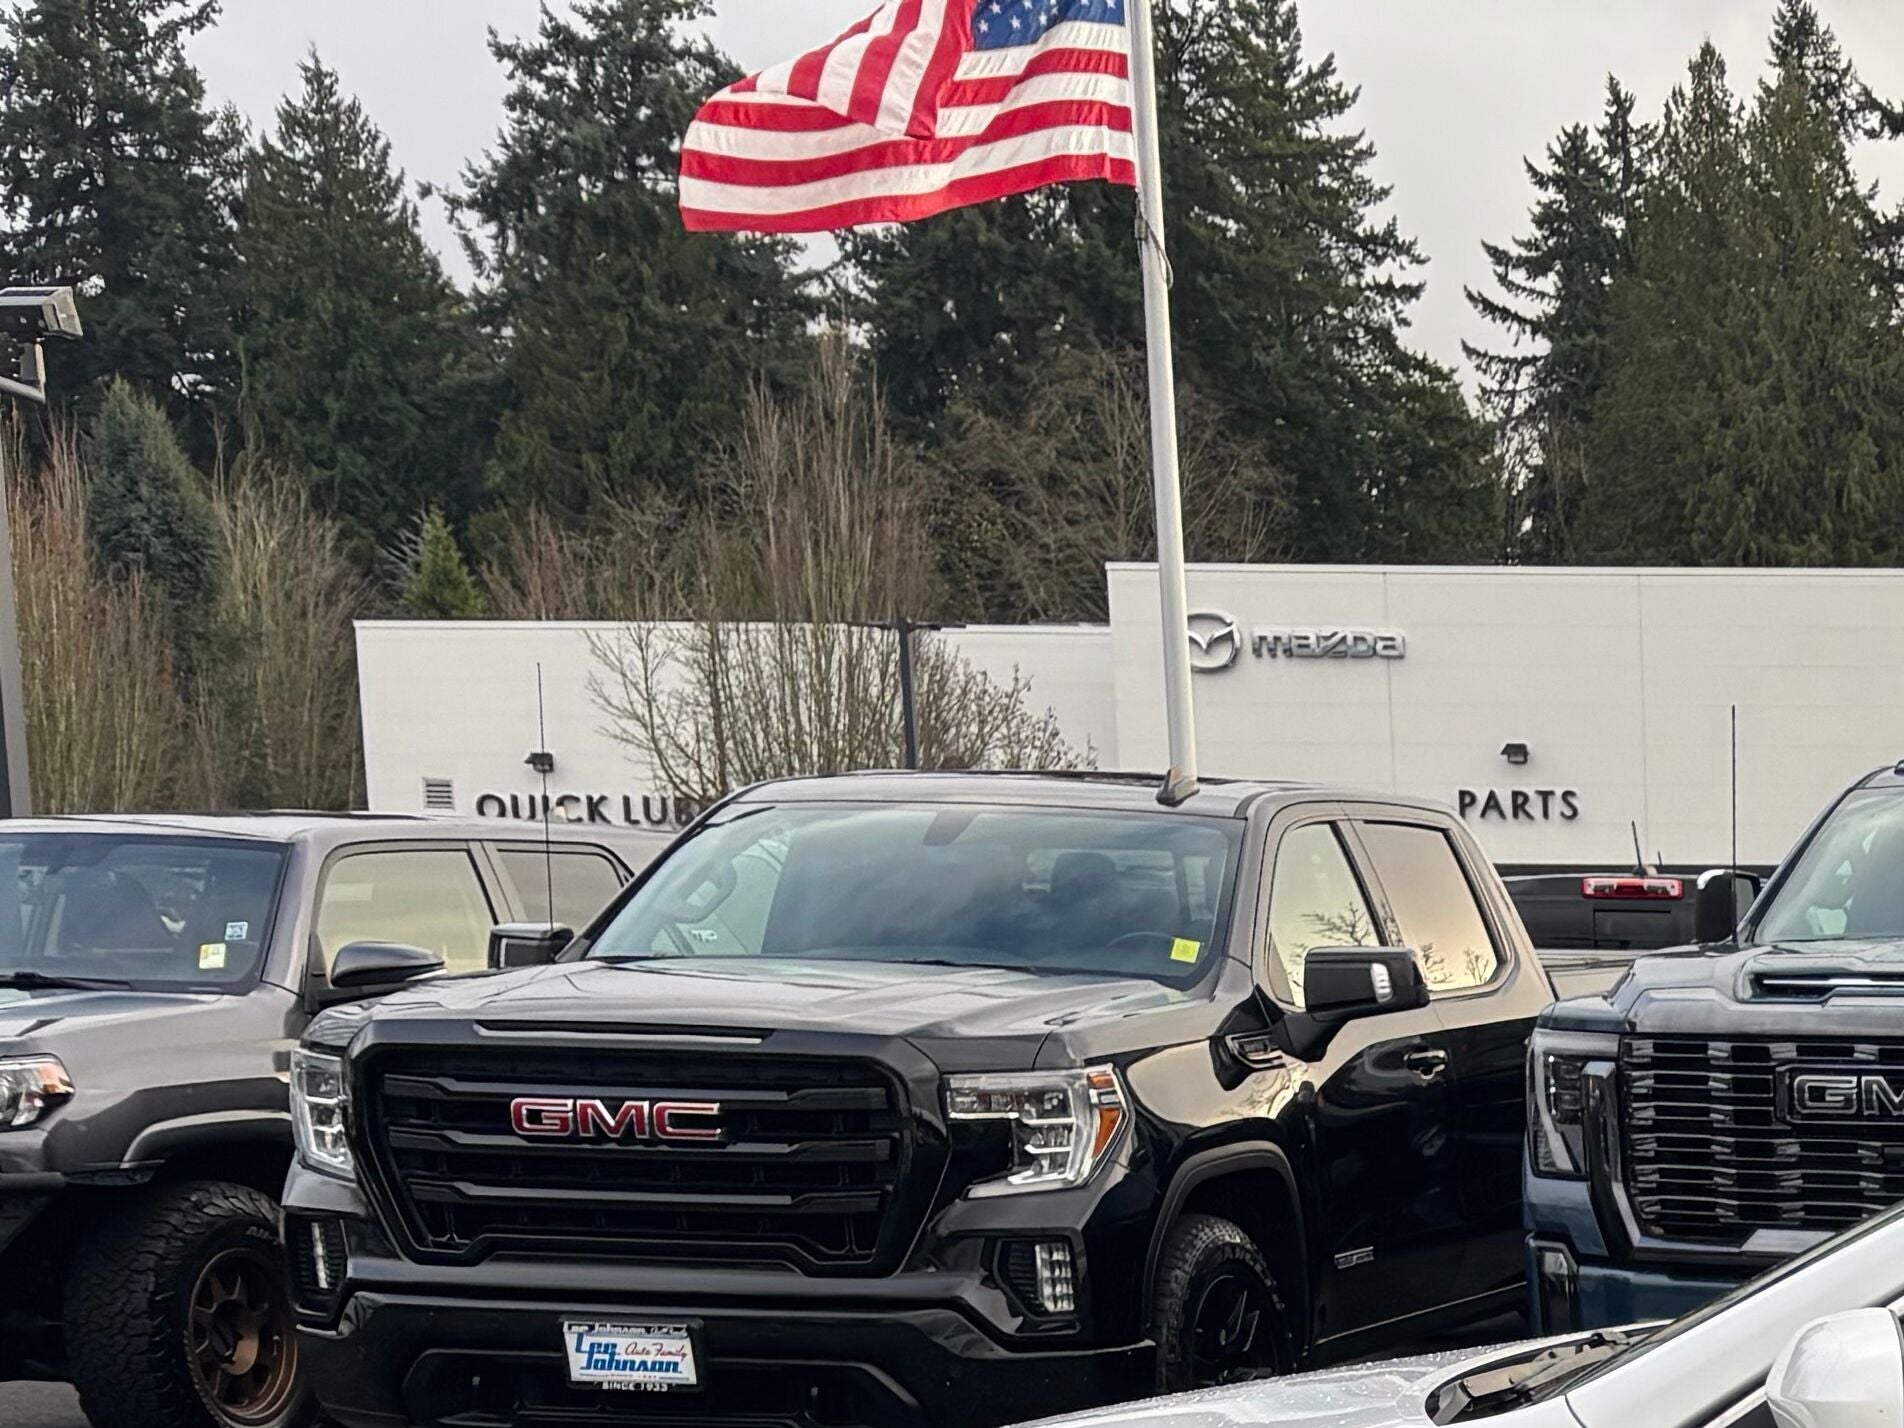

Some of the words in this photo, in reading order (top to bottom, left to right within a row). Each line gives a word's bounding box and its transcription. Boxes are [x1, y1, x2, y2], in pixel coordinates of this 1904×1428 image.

[475, 793, 612, 825] QUICK
[1458, 788, 1581, 822] PARTS
[511, 1097, 724, 1141] GMC
